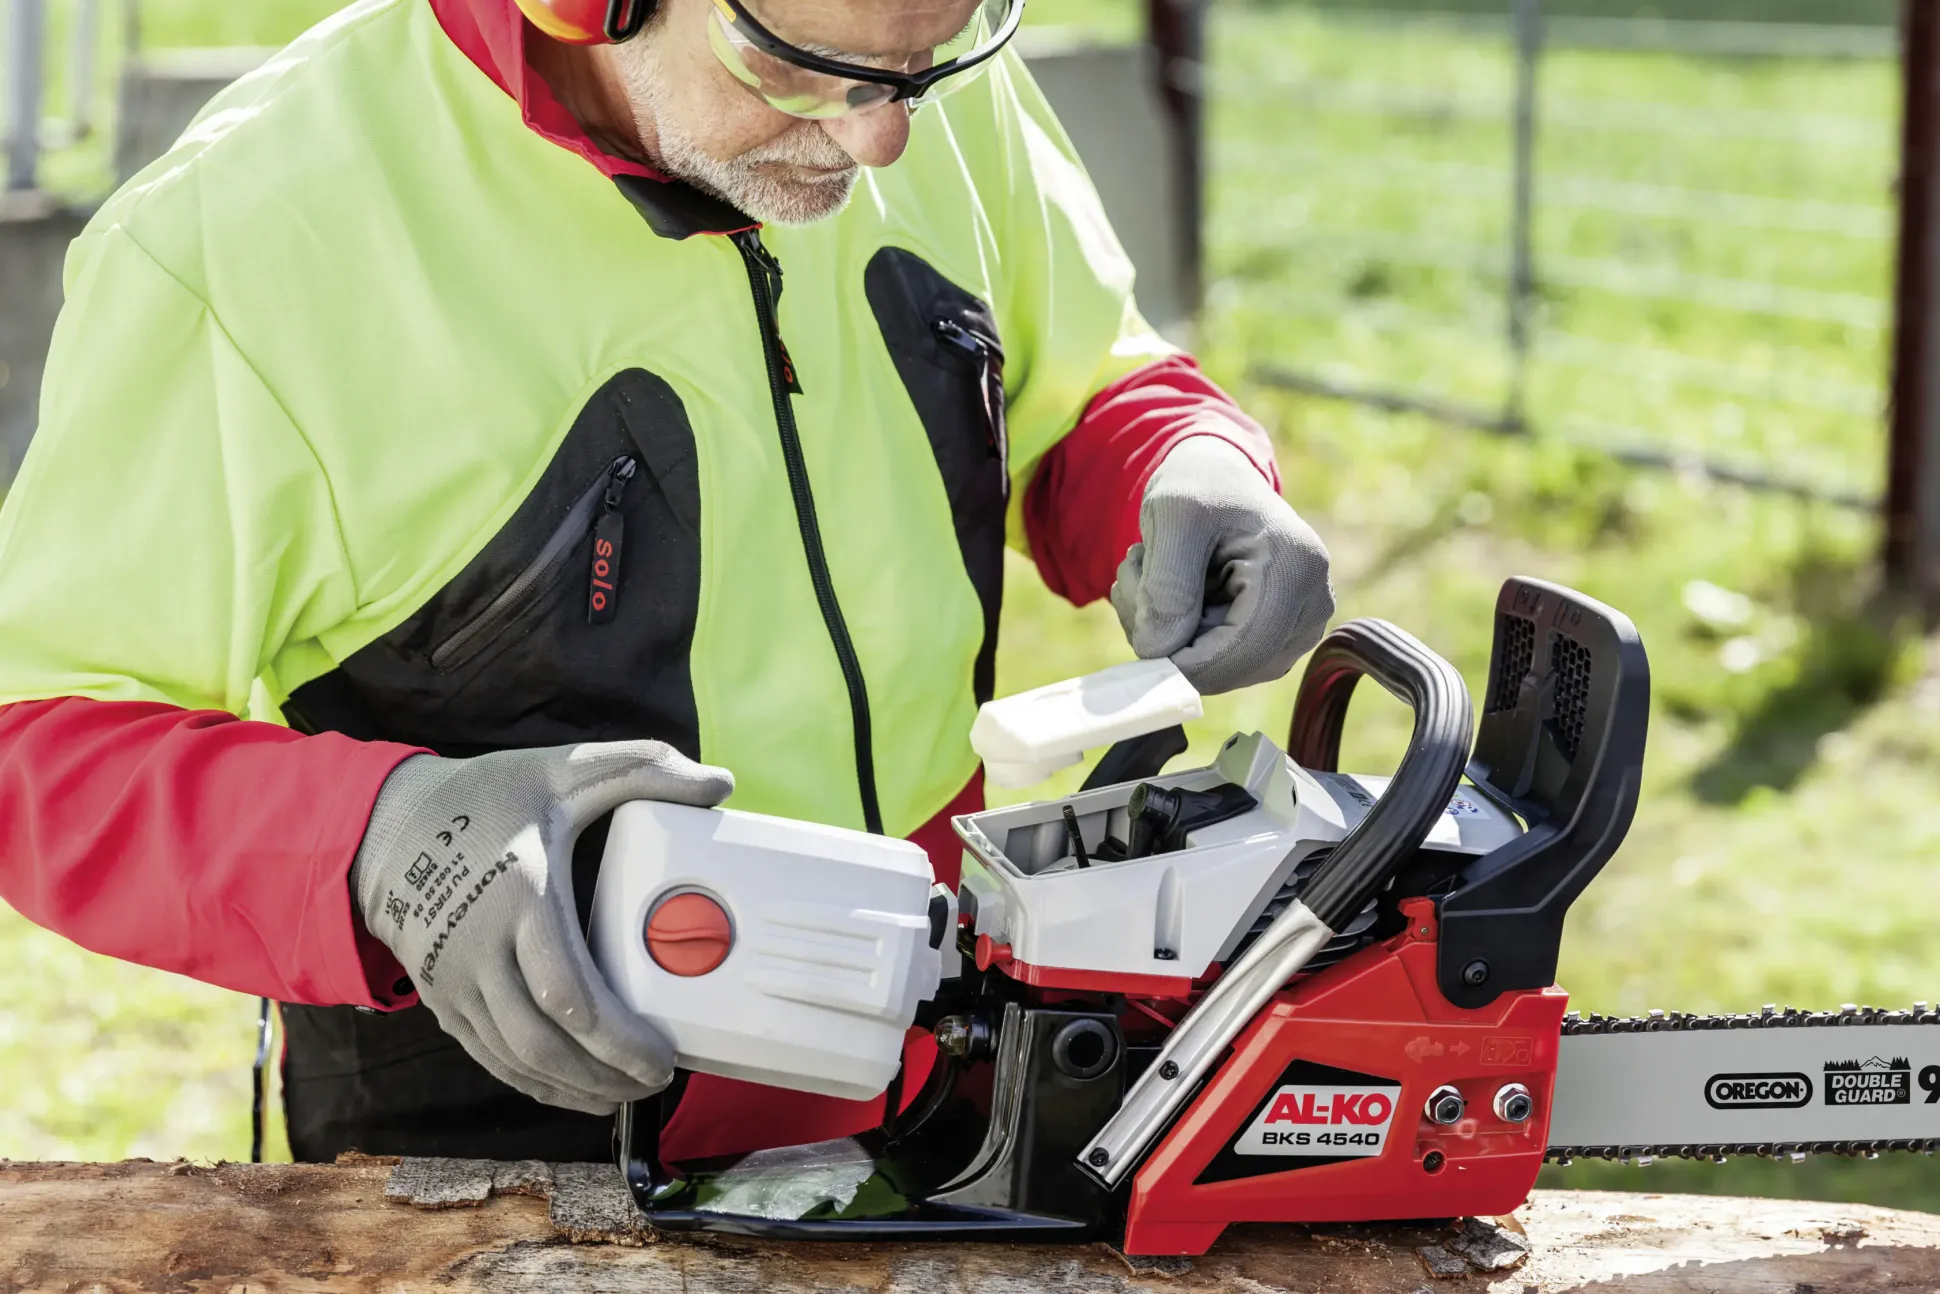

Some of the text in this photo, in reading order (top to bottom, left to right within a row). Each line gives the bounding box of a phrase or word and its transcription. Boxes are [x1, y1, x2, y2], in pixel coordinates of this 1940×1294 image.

[591, 538, 613, 611] solo
[423, 865, 470, 929] PU FIRST
[420, 851, 519, 987] Honeywell
[1715, 1081, 1800, 1101] OREGON
[1831, 1074, 1903, 1089] DOUBLE
[1264, 1092, 1392, 1126] AL-KO
[1262, 1132, 1380, 1146] BKS 4540
